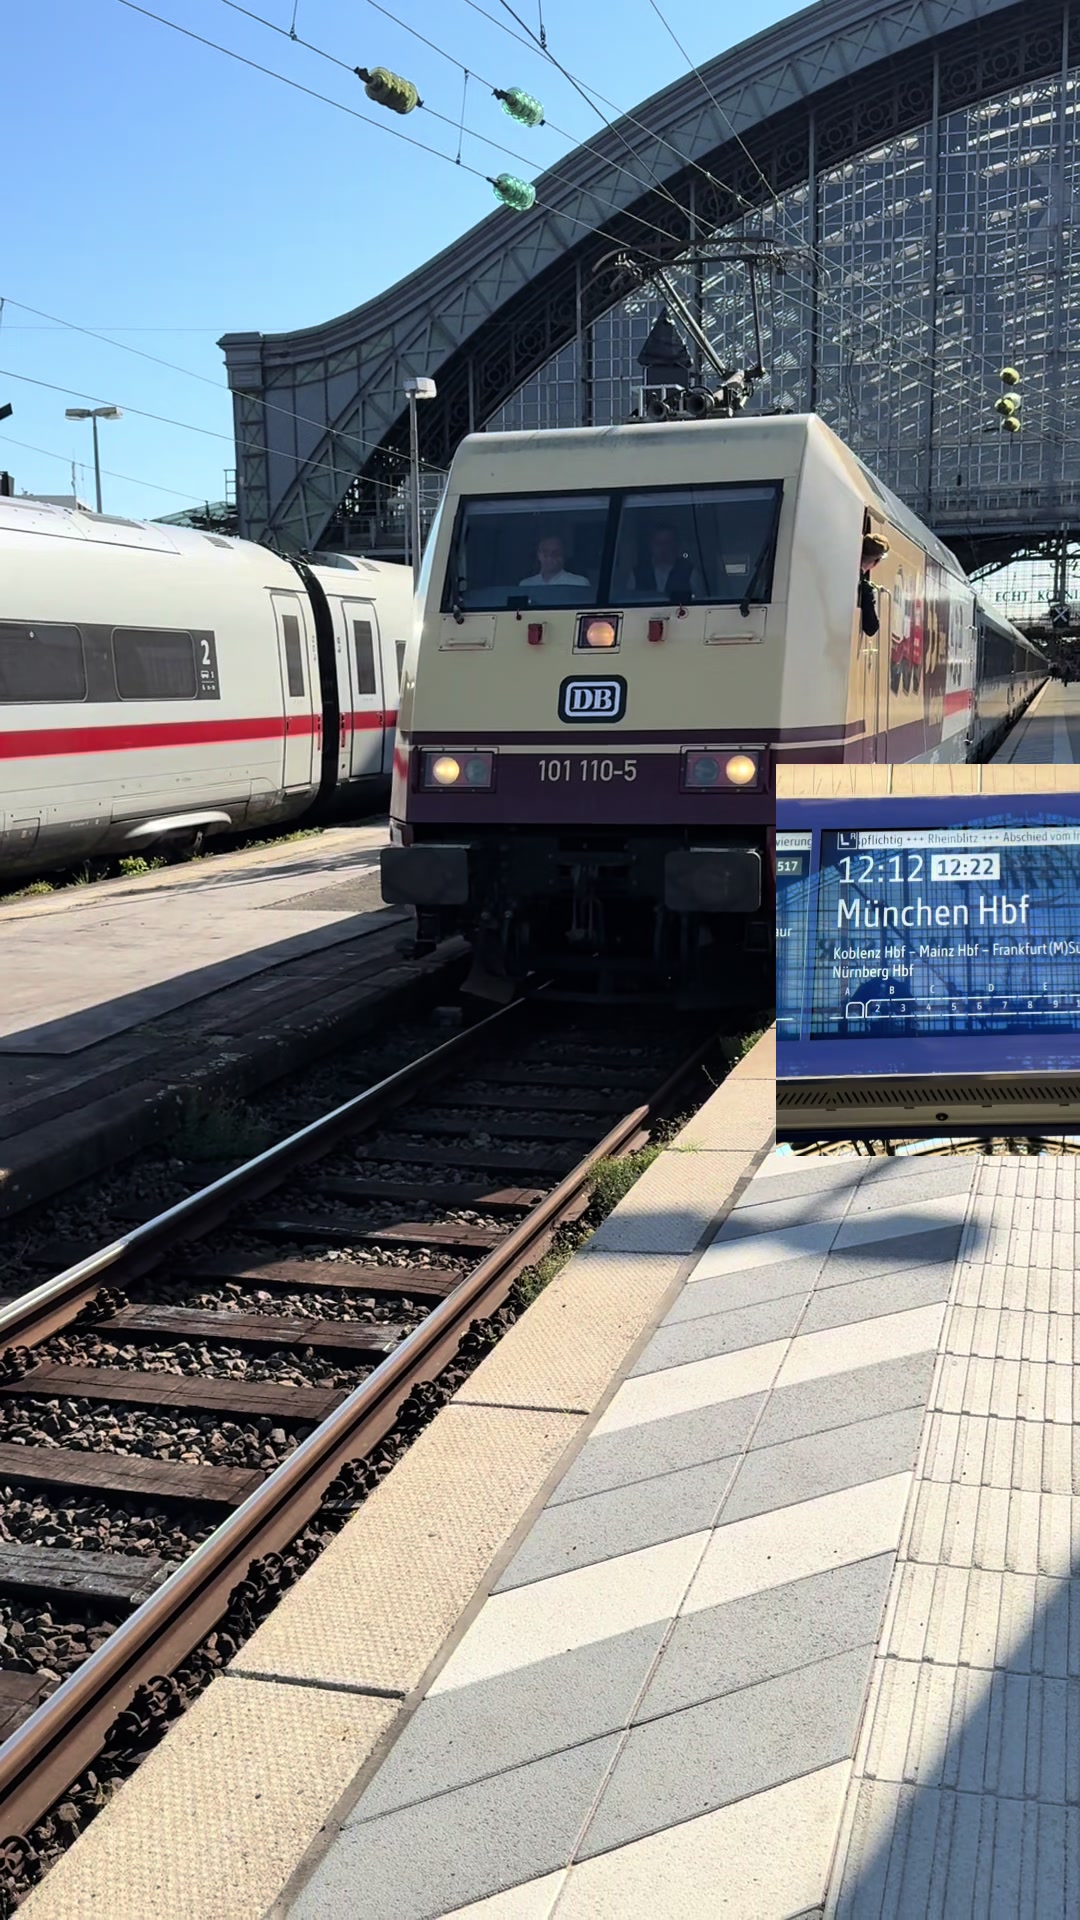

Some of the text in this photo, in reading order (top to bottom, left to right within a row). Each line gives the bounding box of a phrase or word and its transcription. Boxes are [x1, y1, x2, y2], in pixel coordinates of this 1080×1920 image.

[995, 591, 1028, 602] ECHT
[200, 639, 211, 665] 2
[571, 688, 612, 710] DB
[539, 760, 637, 781] 101 110-5
[928, 833, 978, 844] Rheinblitz
[1003, 831, 1048, 842] Abschied
[1050, 833, 1071, 841] vom
[777, 861, 798, 872] 517
[839, 854, 993, 883] 12:12 12:22
[837, 894, 1030, 928] München Hbf
[833, 946, 881, 960] Koblenz
[884, 945, 906, 959] Hbf
[919, 945, 955, 958] Mainz
[958, 943, 980, 957] Hbf
[992, 942, 1047, 956] Frankfurt
[832, 964, 914, 980] Nürnberg Hbf
[844, 982, 1048, 996] A B C D E
[875, 1004, 880, 1013] 2
[900, 1003, 906, 1012] 3
[926, 1003, 932, 1012] 4
[951, 1002, 957, 1011] 5
[977, 1001, 983, 1010] 6
[1002, 1001, 1007, 1009] 7
[1027, 1000, 1033, 1009] 8
[1053, 1000, 1059, 1009] 9
